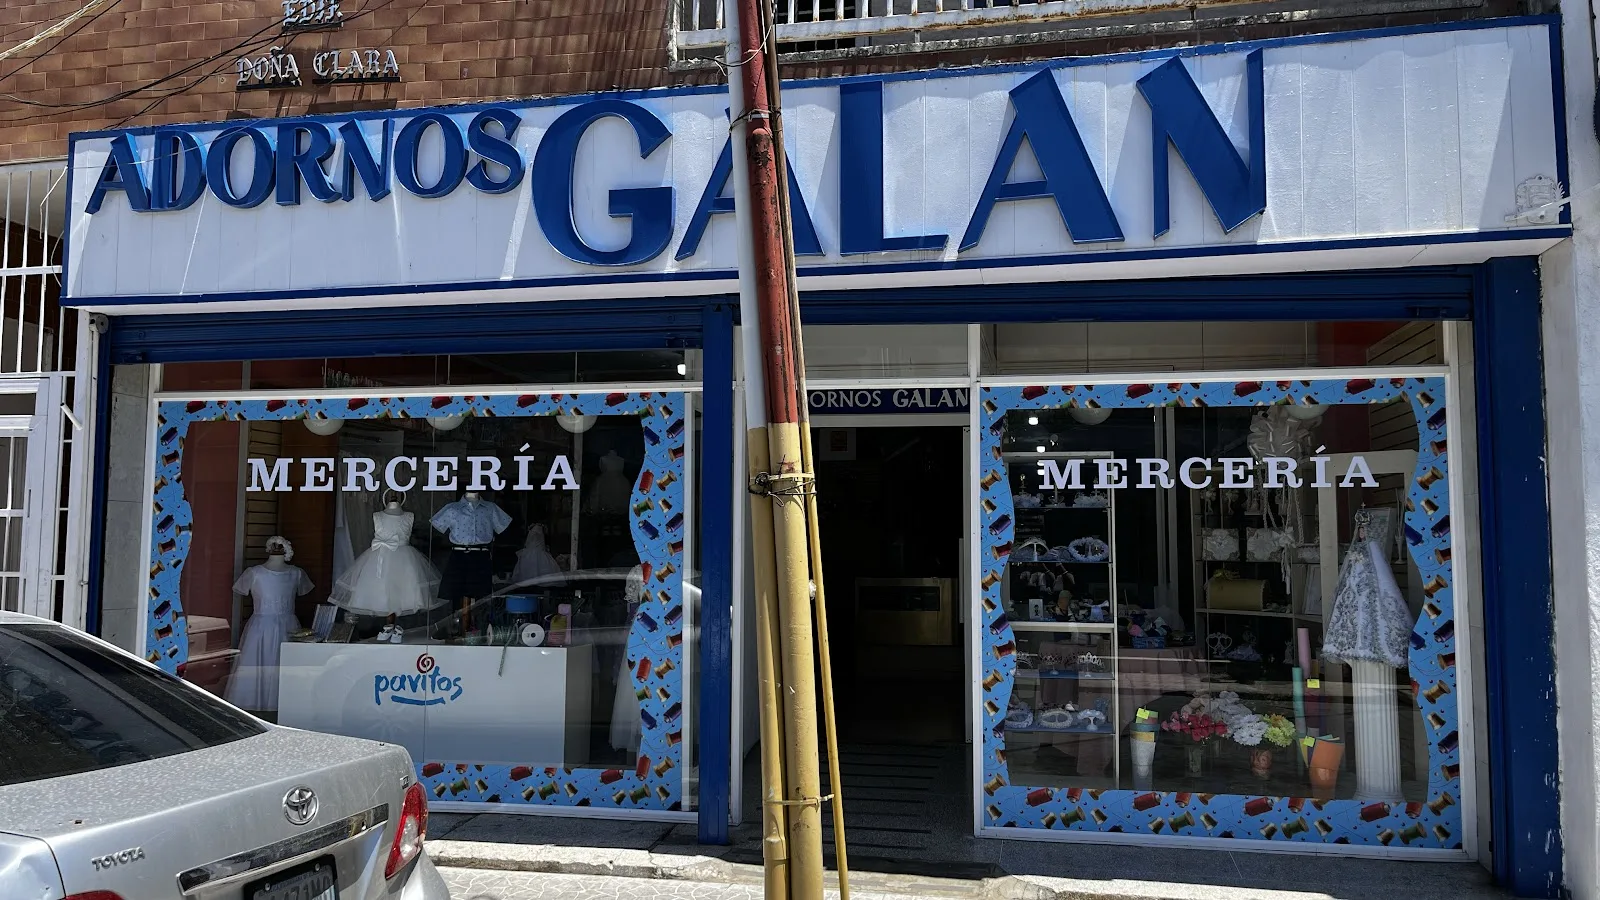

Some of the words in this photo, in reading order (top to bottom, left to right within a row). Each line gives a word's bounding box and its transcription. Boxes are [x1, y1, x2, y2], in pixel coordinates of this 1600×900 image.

[236, 45, 300, 86] DOÑA
[313, 50, 399, 77] CLARA
[85, 107, 525, 215] ADORNOS
[806, 390, 882, 408] ORNOS
[892, 388, 968, 407] GALAN
[246, 442, 581, 493] MERCERÍA
[1038, 445, 1379, 491] MERCERÍA
[375, 653, 463, 705] pavitos
[91, 846, 146, 872] TOYOTA
